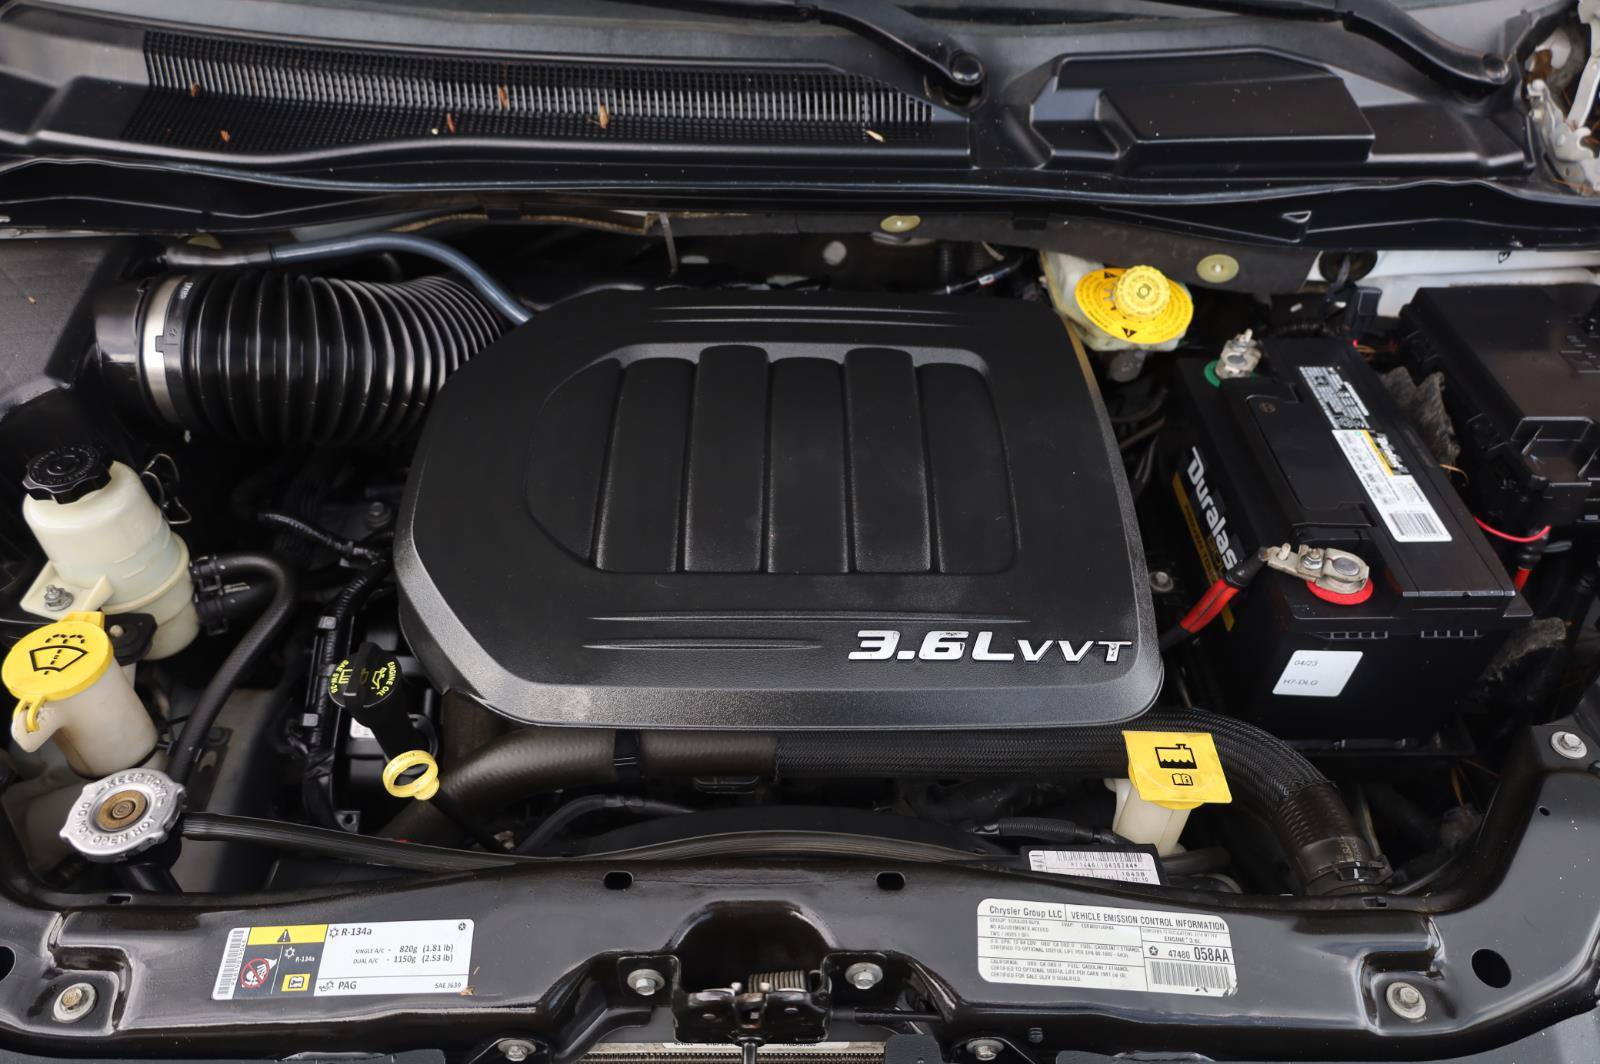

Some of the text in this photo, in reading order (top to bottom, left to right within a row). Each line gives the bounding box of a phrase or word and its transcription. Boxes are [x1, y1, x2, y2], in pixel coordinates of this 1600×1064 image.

[1187, 446, 1239, 571] Duralas
[848, 630, 1133, 662] 3.6L VVT
[376, 661, 397, 696] ENGINE OIL
[104, 773, 145, 788] KEEP
[92, 833, 128, 845] OPEN
[131, 815, 156, 837] HOT
[989, 905, 1063, 918] Chrysler Group LLC
[1071, 911, 1101, 921] VEHICLE
[1103, 913, 1138, 924] EMISSION
[1140, 916, 1174, 927] CONTROL
[1176, 919, 1225, 931] INFORMATION
[341, 927, 372, 936] R-134a
[399, 945, 418, 953] 820g
[422, 944, 441, 953] (1.81
[443, 944, 454, 952] lb)
[1168, 946, 1230, 962] 47480 058AA
[393, 955, 416, 964] 1150g
[422, 954, 441, 964] (2.53
[442, 953, 453, 963] lb)
[338, 981, 357, 990] PAG
